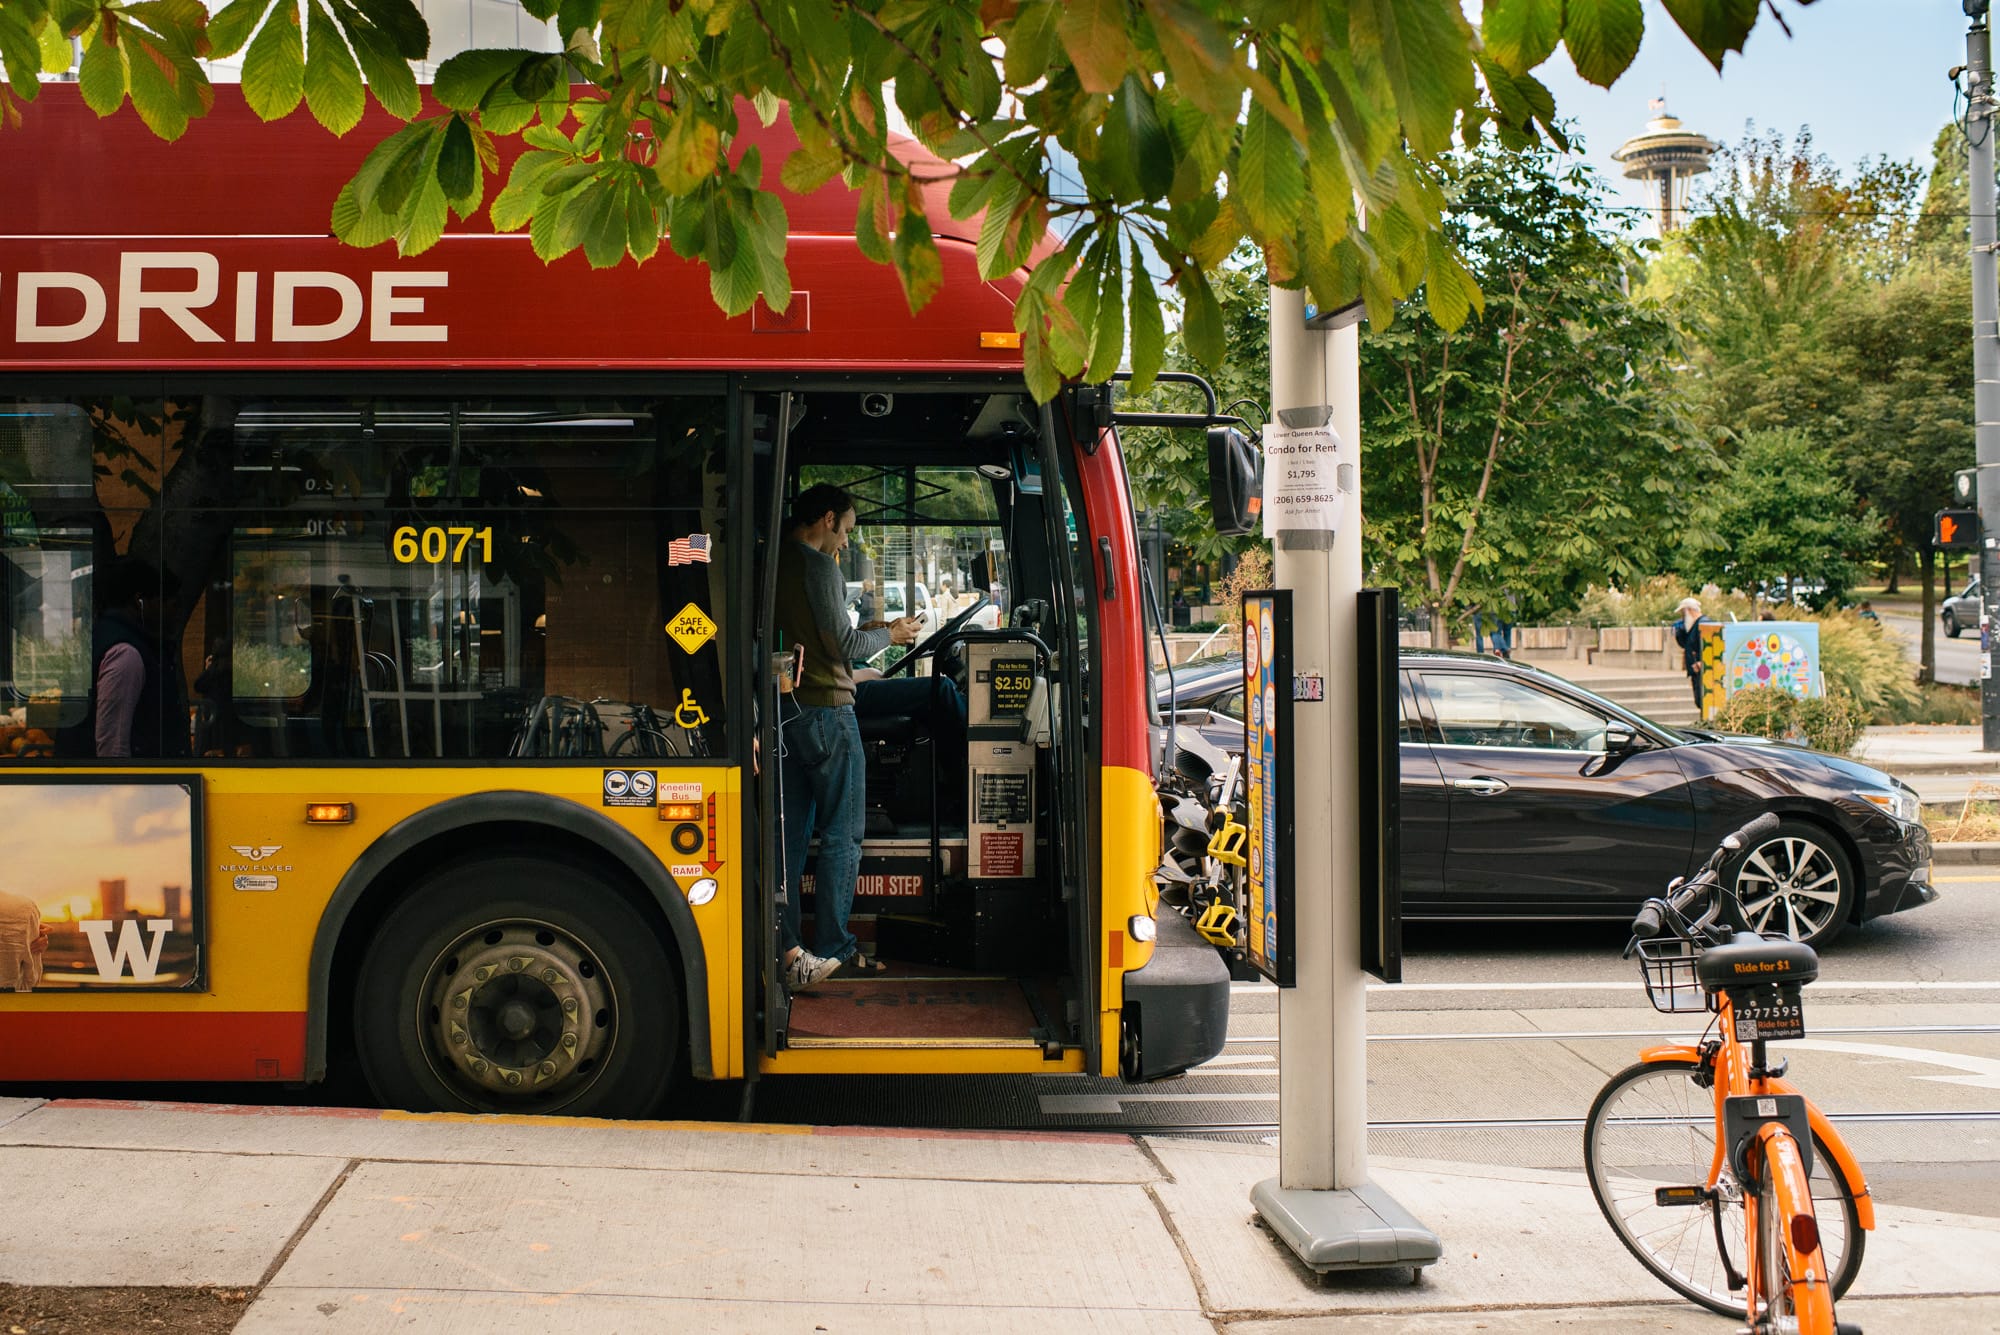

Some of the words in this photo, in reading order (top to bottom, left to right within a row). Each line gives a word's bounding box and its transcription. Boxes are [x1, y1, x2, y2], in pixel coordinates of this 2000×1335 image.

[0, 251, 449, 343] DRIDE
[1268, 445, 1296, 454] Condo
[1298, 444, 1312, 453] for
[1316, 444, 1337, 452] Rent
[1288, 470, 1316, 479] $1,795
[1274, 496, 1294, 505] (206)
[1296, 494, 1334, 504] 659-8625
[393, 526, 492, 564] 6071
[996, 676, 1031, 691] $2.50
[660, 784, 701, 792] Kneeling
[856, 876, 884, 895] OUR
[889, 875, 922, 895] STEP
[79, 920, 173, 980] W
[1734, 962, 1759, 973] Ride
[1760, 962, 1774, 972] for
[1776, 960, 1791, 971] $1
[1735, 1006, 1799, 1020] 7977595
